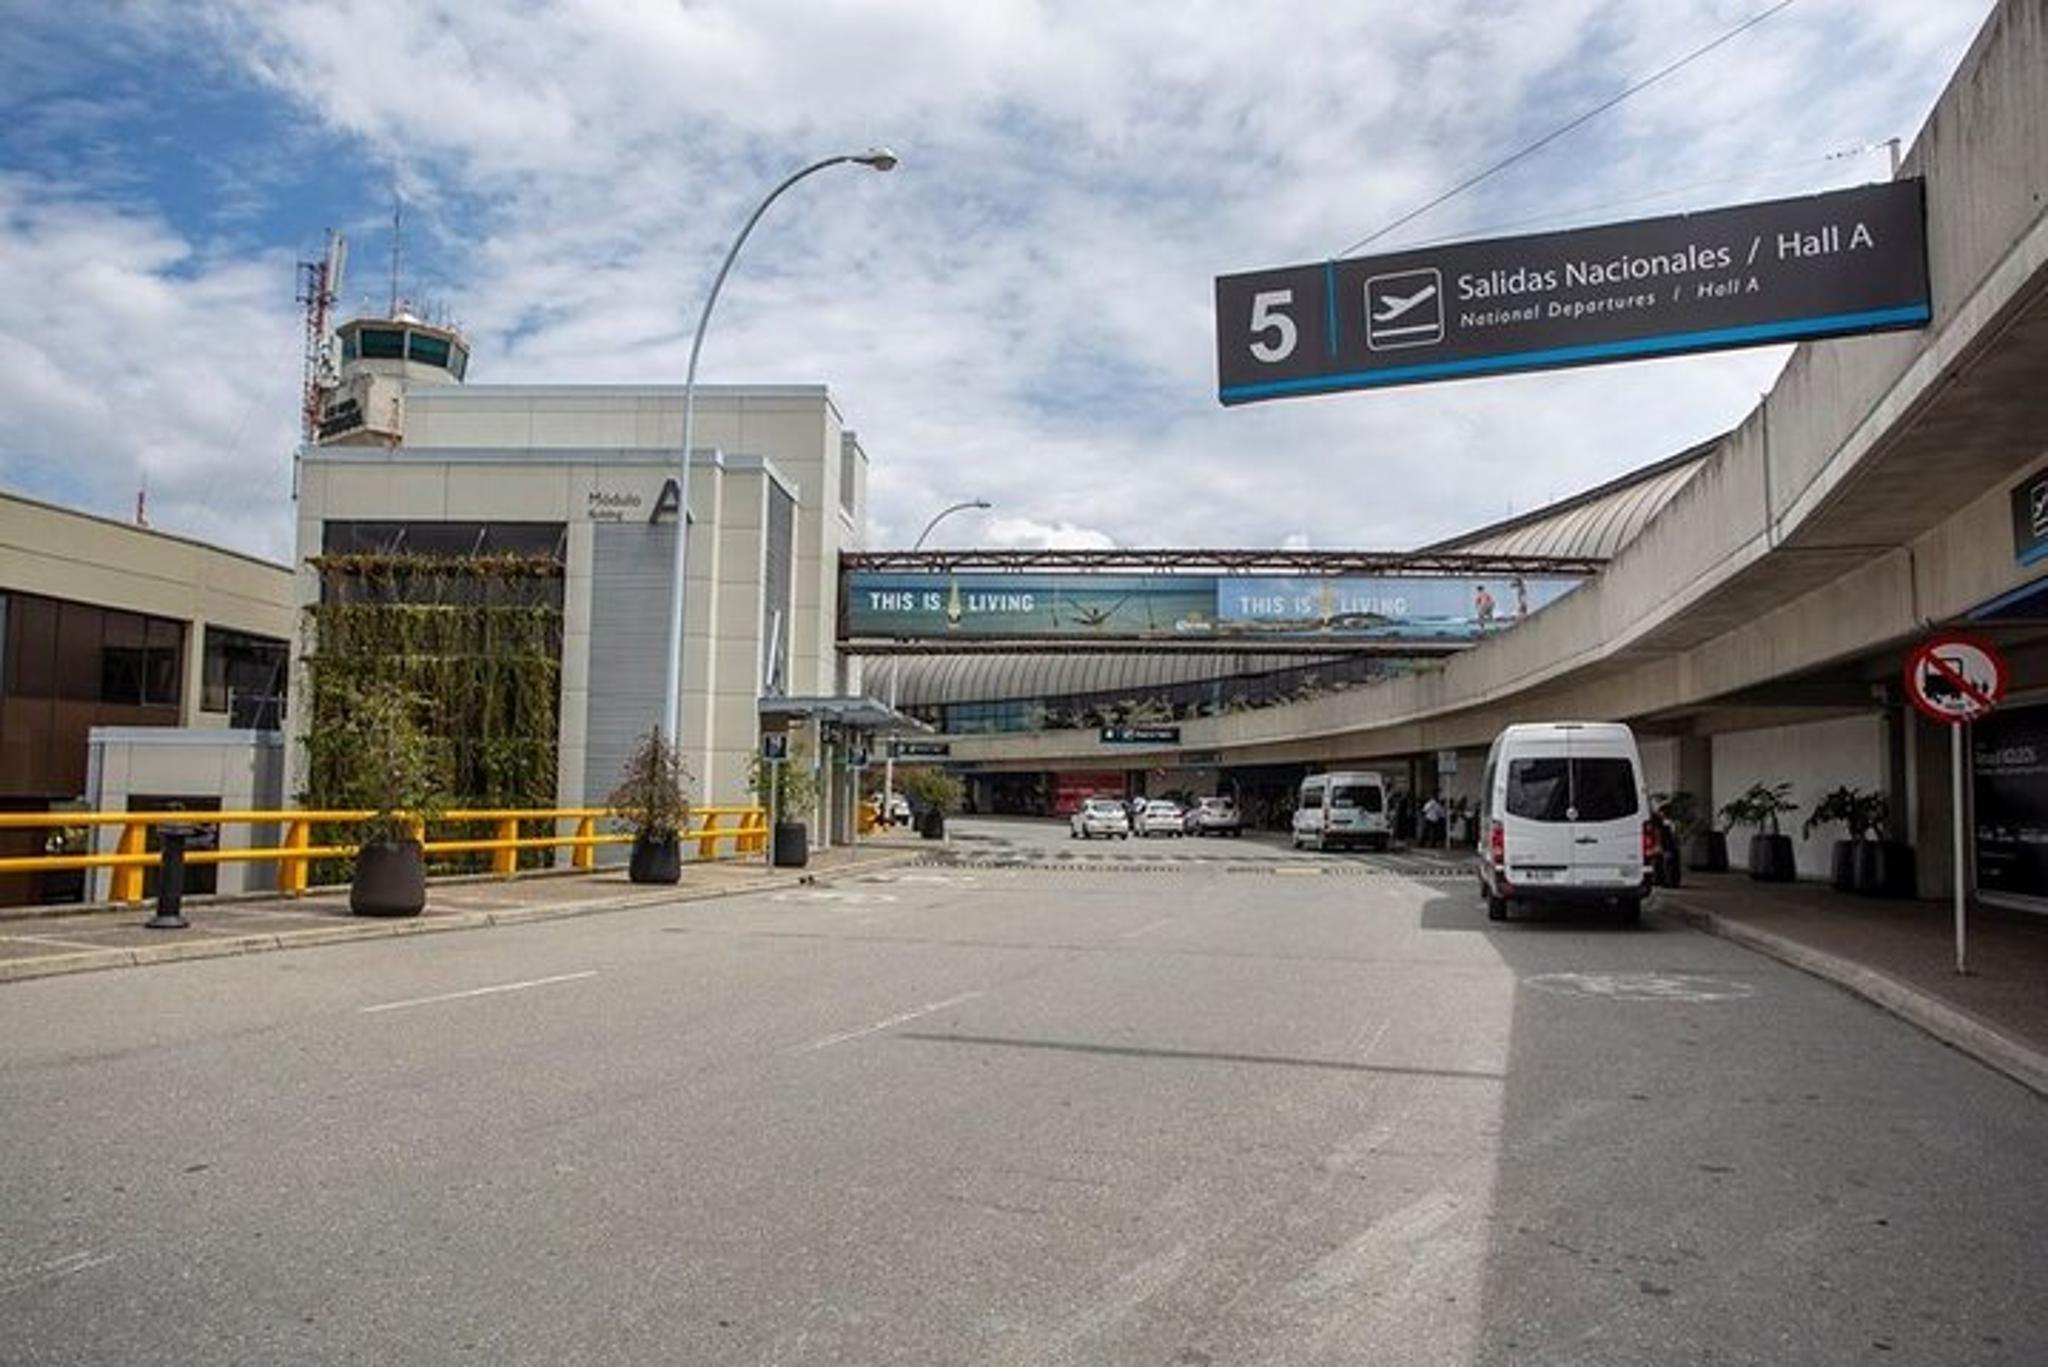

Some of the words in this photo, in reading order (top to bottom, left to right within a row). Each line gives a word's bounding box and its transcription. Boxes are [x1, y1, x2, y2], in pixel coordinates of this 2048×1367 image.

[1457, 267, 1558, 300] Salidas
[1565, 245, 1732, 288] Nacionales
[1747, 236, 1762, 265] /
[1777, 225, 1839, 260] Hall
[1850, 222, 1875, 249] A
[1249, 289, 1297, 363] 5
[1460, 304, 1540, 328] National
[1547, 292, 1656, 319] Departures
[1673, 284, 1681, 301] /
[1697, 278, 1741, 298] Hall
[1745, 276, 1760, 293] A
[649, 478, 694, 525] A
[870, 591, 914, 611] THIS
[922, 591, 942, 611] IS
[968, 593, 1035, 613] LIVING
[1239, 597, 1285, 614] THIS
[1294, 597, 1312, 614] IS
[1340, 597, 1408, 614] LIVING
